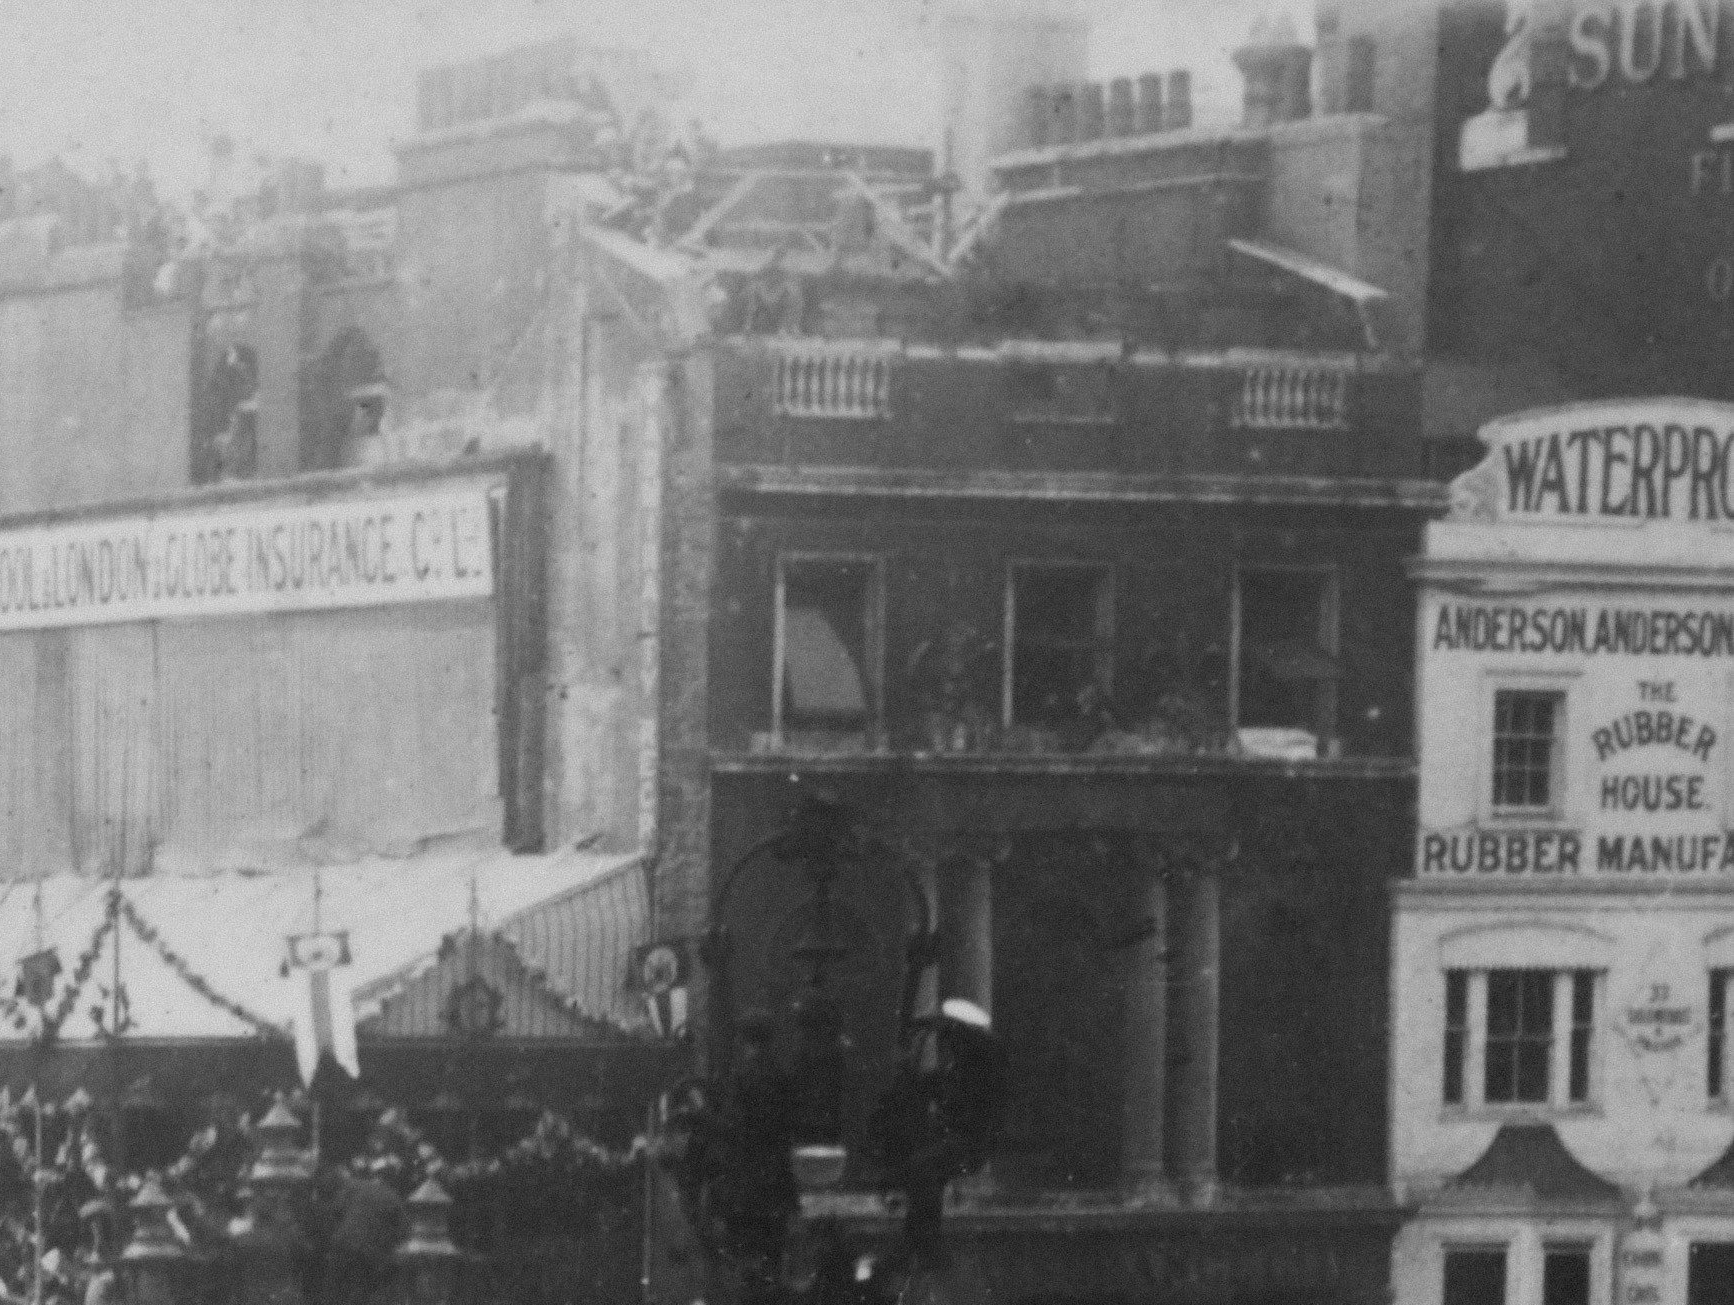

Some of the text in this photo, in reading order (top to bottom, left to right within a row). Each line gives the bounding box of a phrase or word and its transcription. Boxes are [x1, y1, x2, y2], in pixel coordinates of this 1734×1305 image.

[1569, 0, 1721, 90] SUN
[247, 512, 397, 593] INSURANCE
[1636, 681, 1677, 703] THE
[1591, 710, 1718, 763] RUBBER
[1423, 834, 1582, 875] RUBBER
